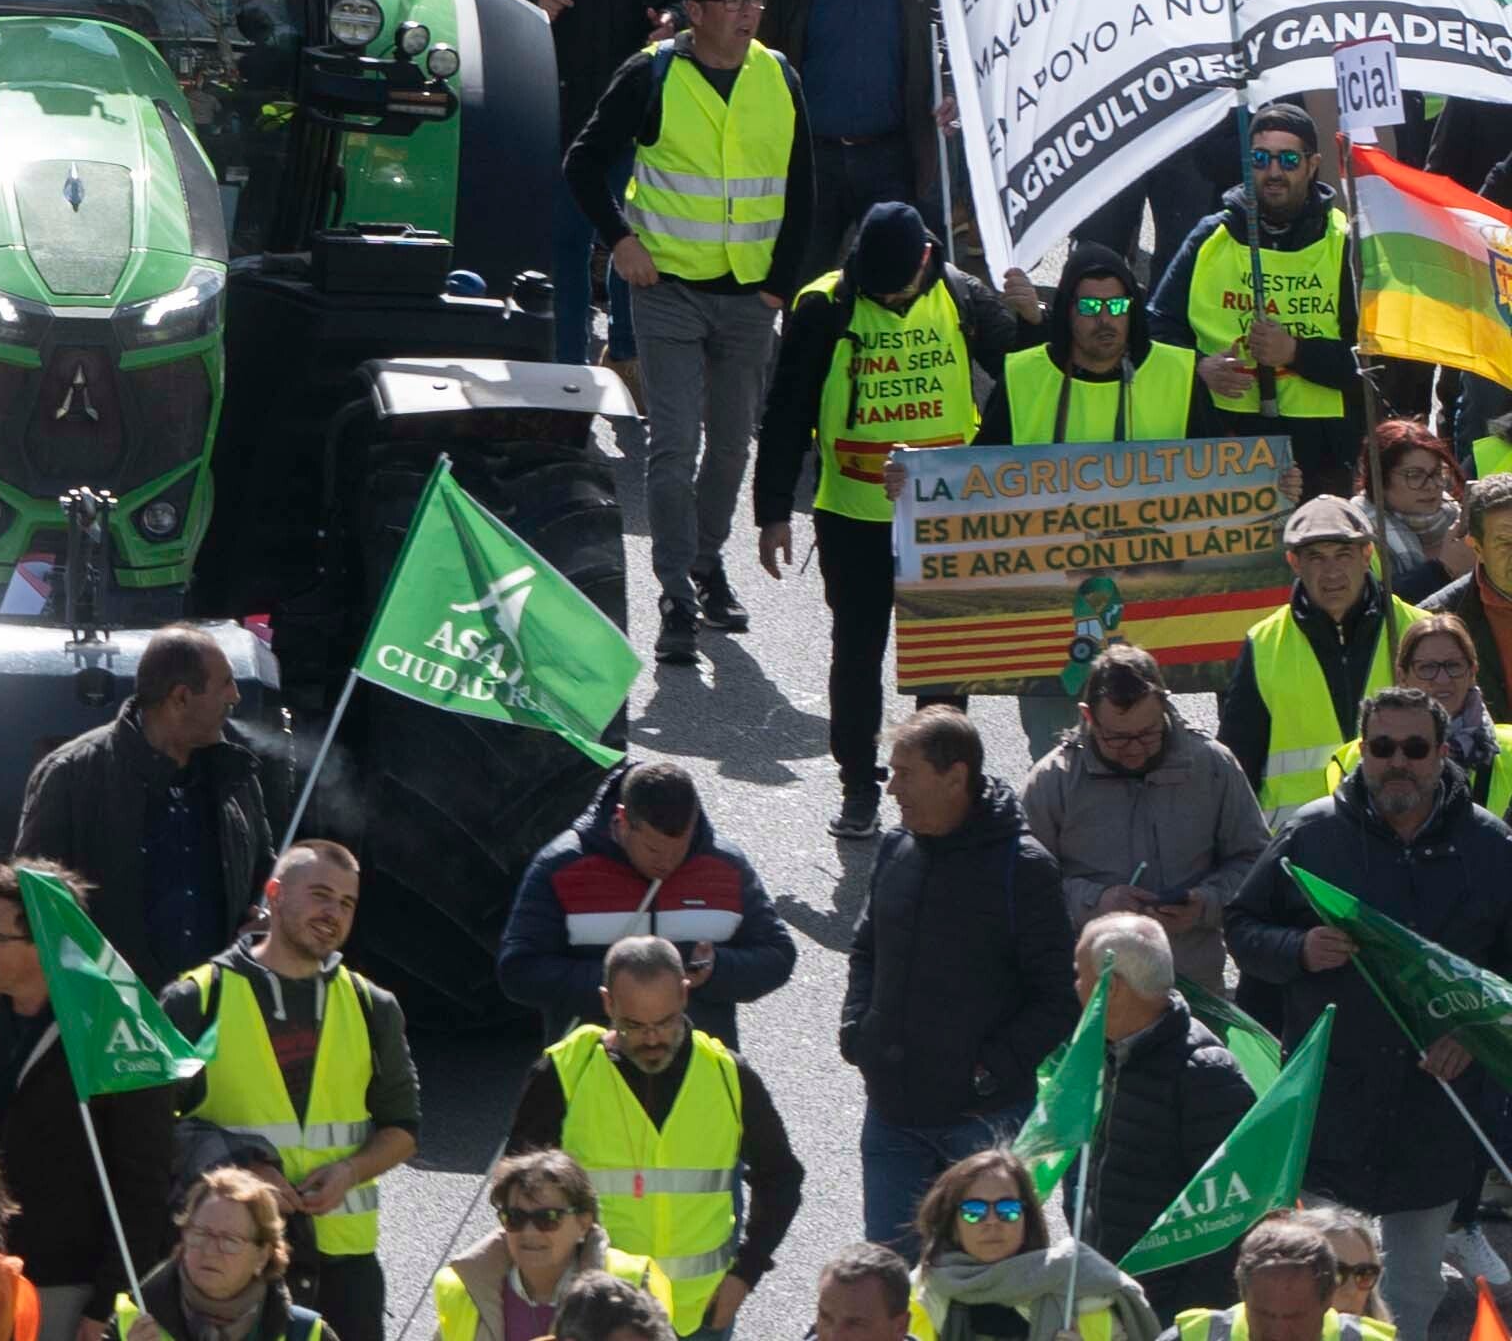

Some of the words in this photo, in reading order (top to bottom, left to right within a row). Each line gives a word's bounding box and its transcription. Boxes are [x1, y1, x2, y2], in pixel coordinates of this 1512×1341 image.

[1128, 3, 1155, 39] A
[1336, 51, 1397, 118] icia!
[1008, 48, 1249, 231] AGRICULTORES
[1287, 289, 1337, 318] SERÁ
[848, 355, 900, 377] UINA
[905, 347, 958, 373] SERÁ
[914, 476, 955, 506] LA
[958, 437, 1279, 502] AGRICULTURA
[916, 517, 952, 546] ES
[959, 511, 1032, 542] MUY
[1040, 495, 1129, 537] FÁCIL
[1137, 486, 1279, 531] CUANDO
[922, 554, 960, 582] SE
[968, 548, 1036, 576] ARA
[1043, 539, 1120, 571] CON
[1128, 534, 1178, 563] UN
[1185, 517, 1273, 559] LÁPIZ
[375, 643, 496, 703] CIUDAD
[1428, 983, 1506, 1021] CIUDA
[1165, 1170, 1252, 1225] AJA
